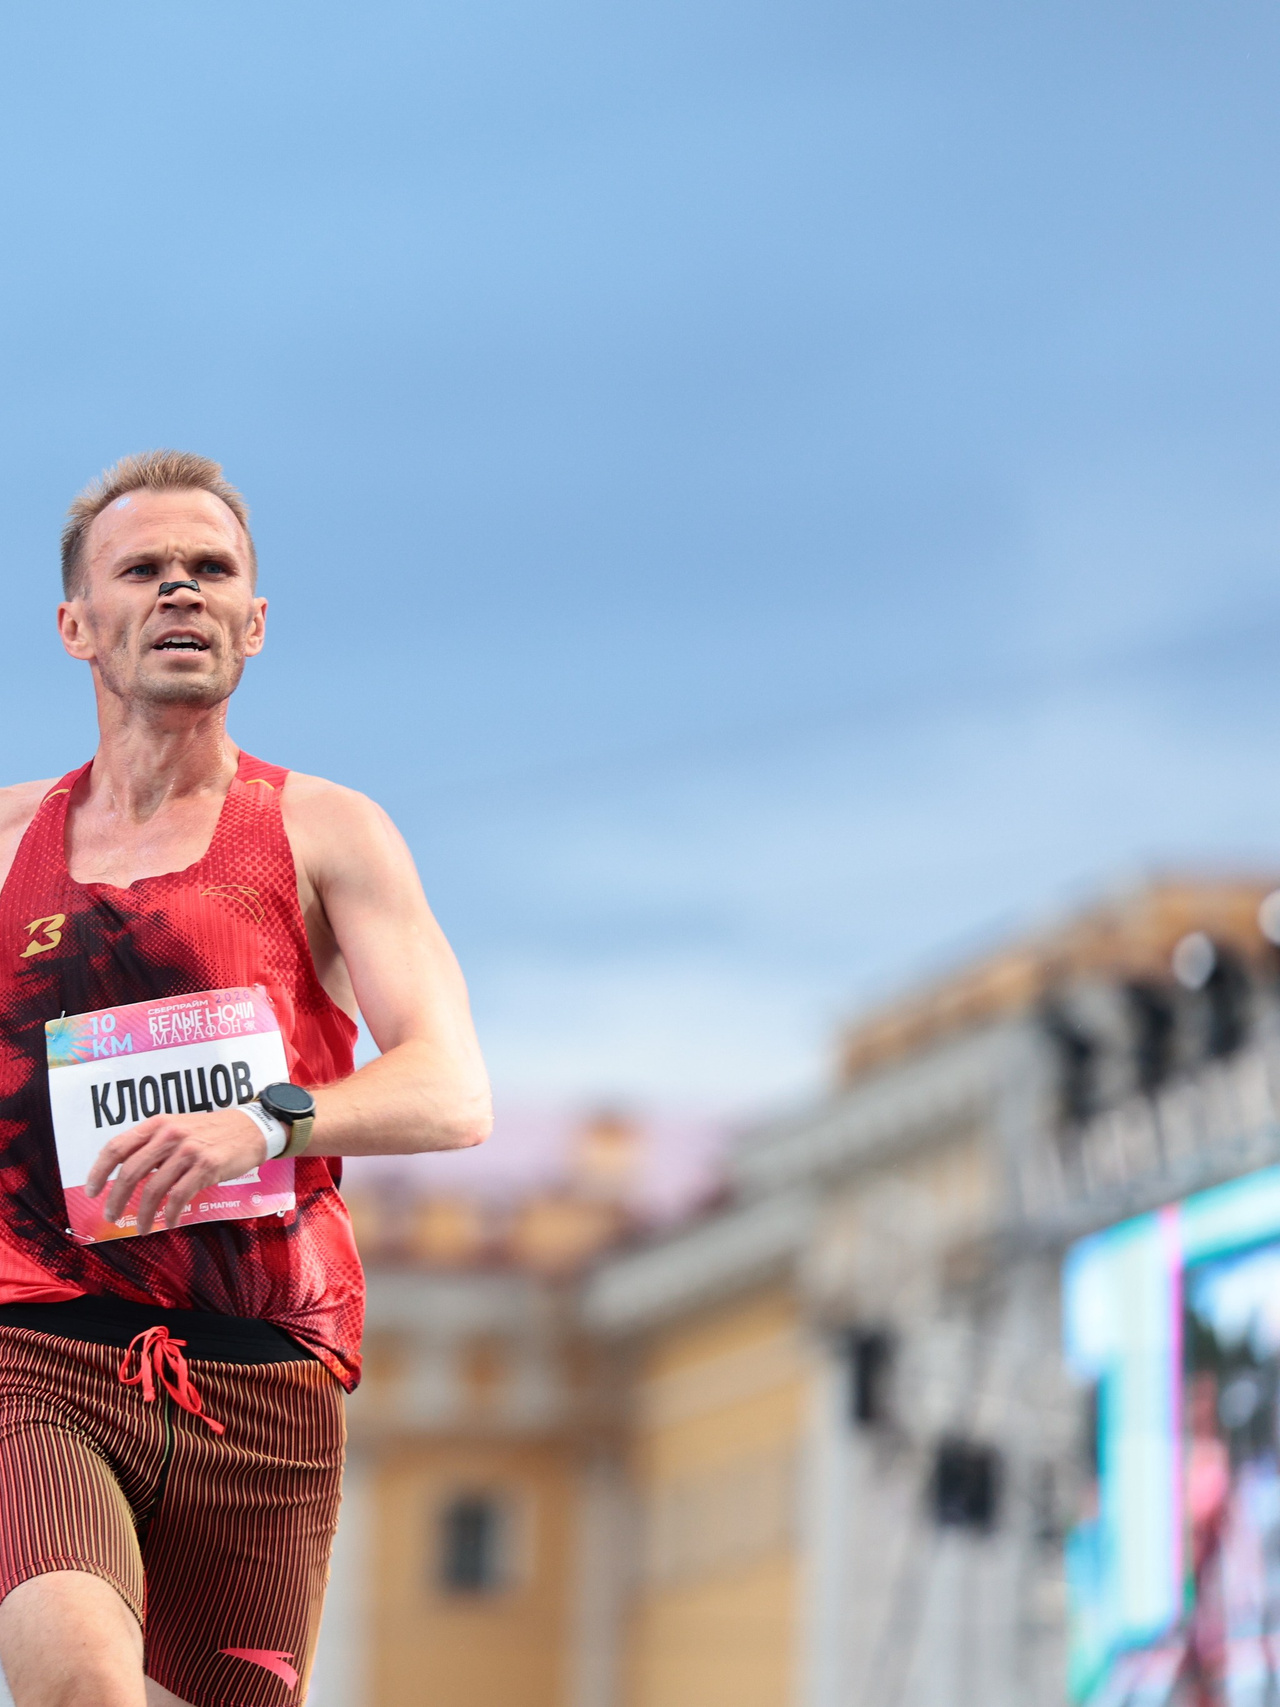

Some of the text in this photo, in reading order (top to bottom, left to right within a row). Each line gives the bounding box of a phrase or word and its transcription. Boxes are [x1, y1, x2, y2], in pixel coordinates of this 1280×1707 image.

[147, 999, 209, 1015] СБЕРПРАЙМ
[214, 990, 250, 1003] 2026
[90, 1013, 116, 1035] 10
[148, 1001, 255, 1034] БЕЛЫЕ НОЧИ
[152, 1018, 242, 1047] МАРАФОН
[92, 1033, 133, 1058] КМ
[91, 1060, 254, 1129] КЛОПЦОВ
[210, 1200, 241, 1210] МАГНИТ
